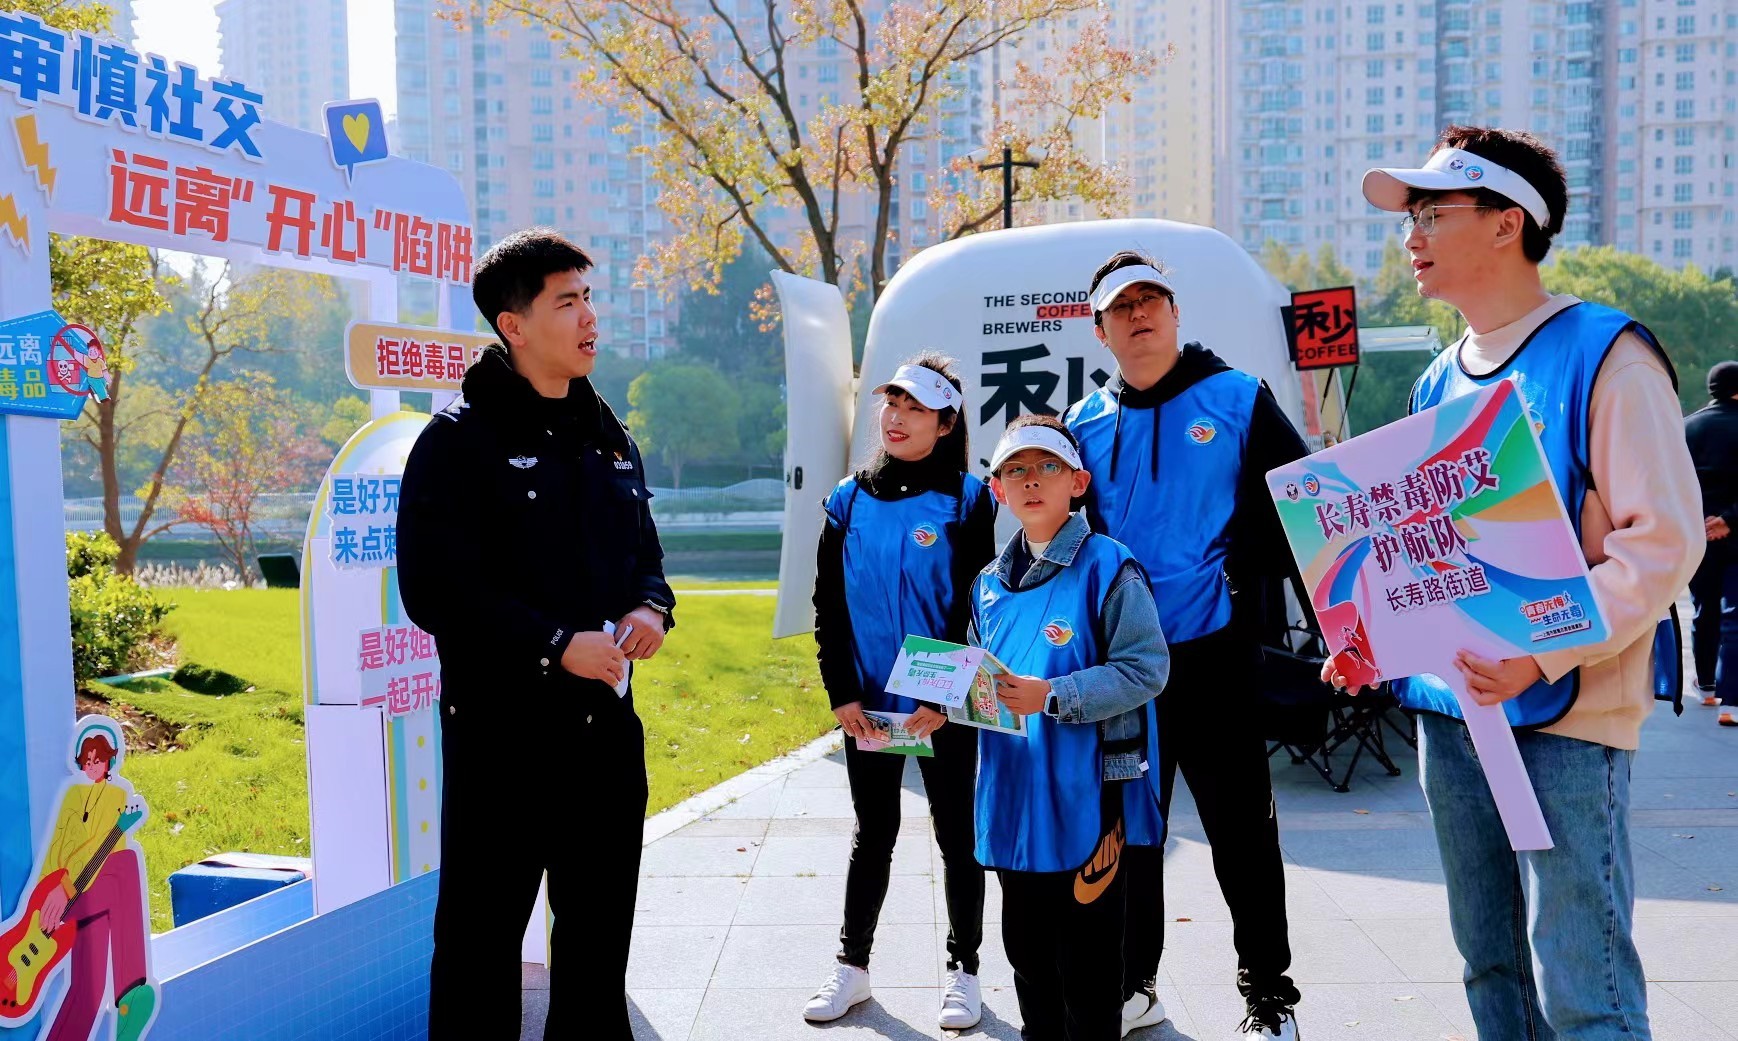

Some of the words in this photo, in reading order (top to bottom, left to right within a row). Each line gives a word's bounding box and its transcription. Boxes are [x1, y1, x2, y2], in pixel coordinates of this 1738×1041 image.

[0, 15, 263, 158] 审慎社交
[984, 295, 1015, 308] THE
[1020, 291, 1088, 306] SECOND
[1037, 304, 1091, 318] COFFE
[983, 320, 1062, 335] BREWERS
[0, 333, 42, 365] 远离
[377, 338, 466, 379] 拒绝毒品
[0, 368, 46, 400] 毒品
[1316, 451, 1497, 540] 长寿禁毒防艾
[1372, 515, 1466, 573] 护航队
[1387, 565, 1489, 612] 长寿路街道
[360, 625, 439, 671] 是好姐
[362, 672, 441, 716] 一起开
